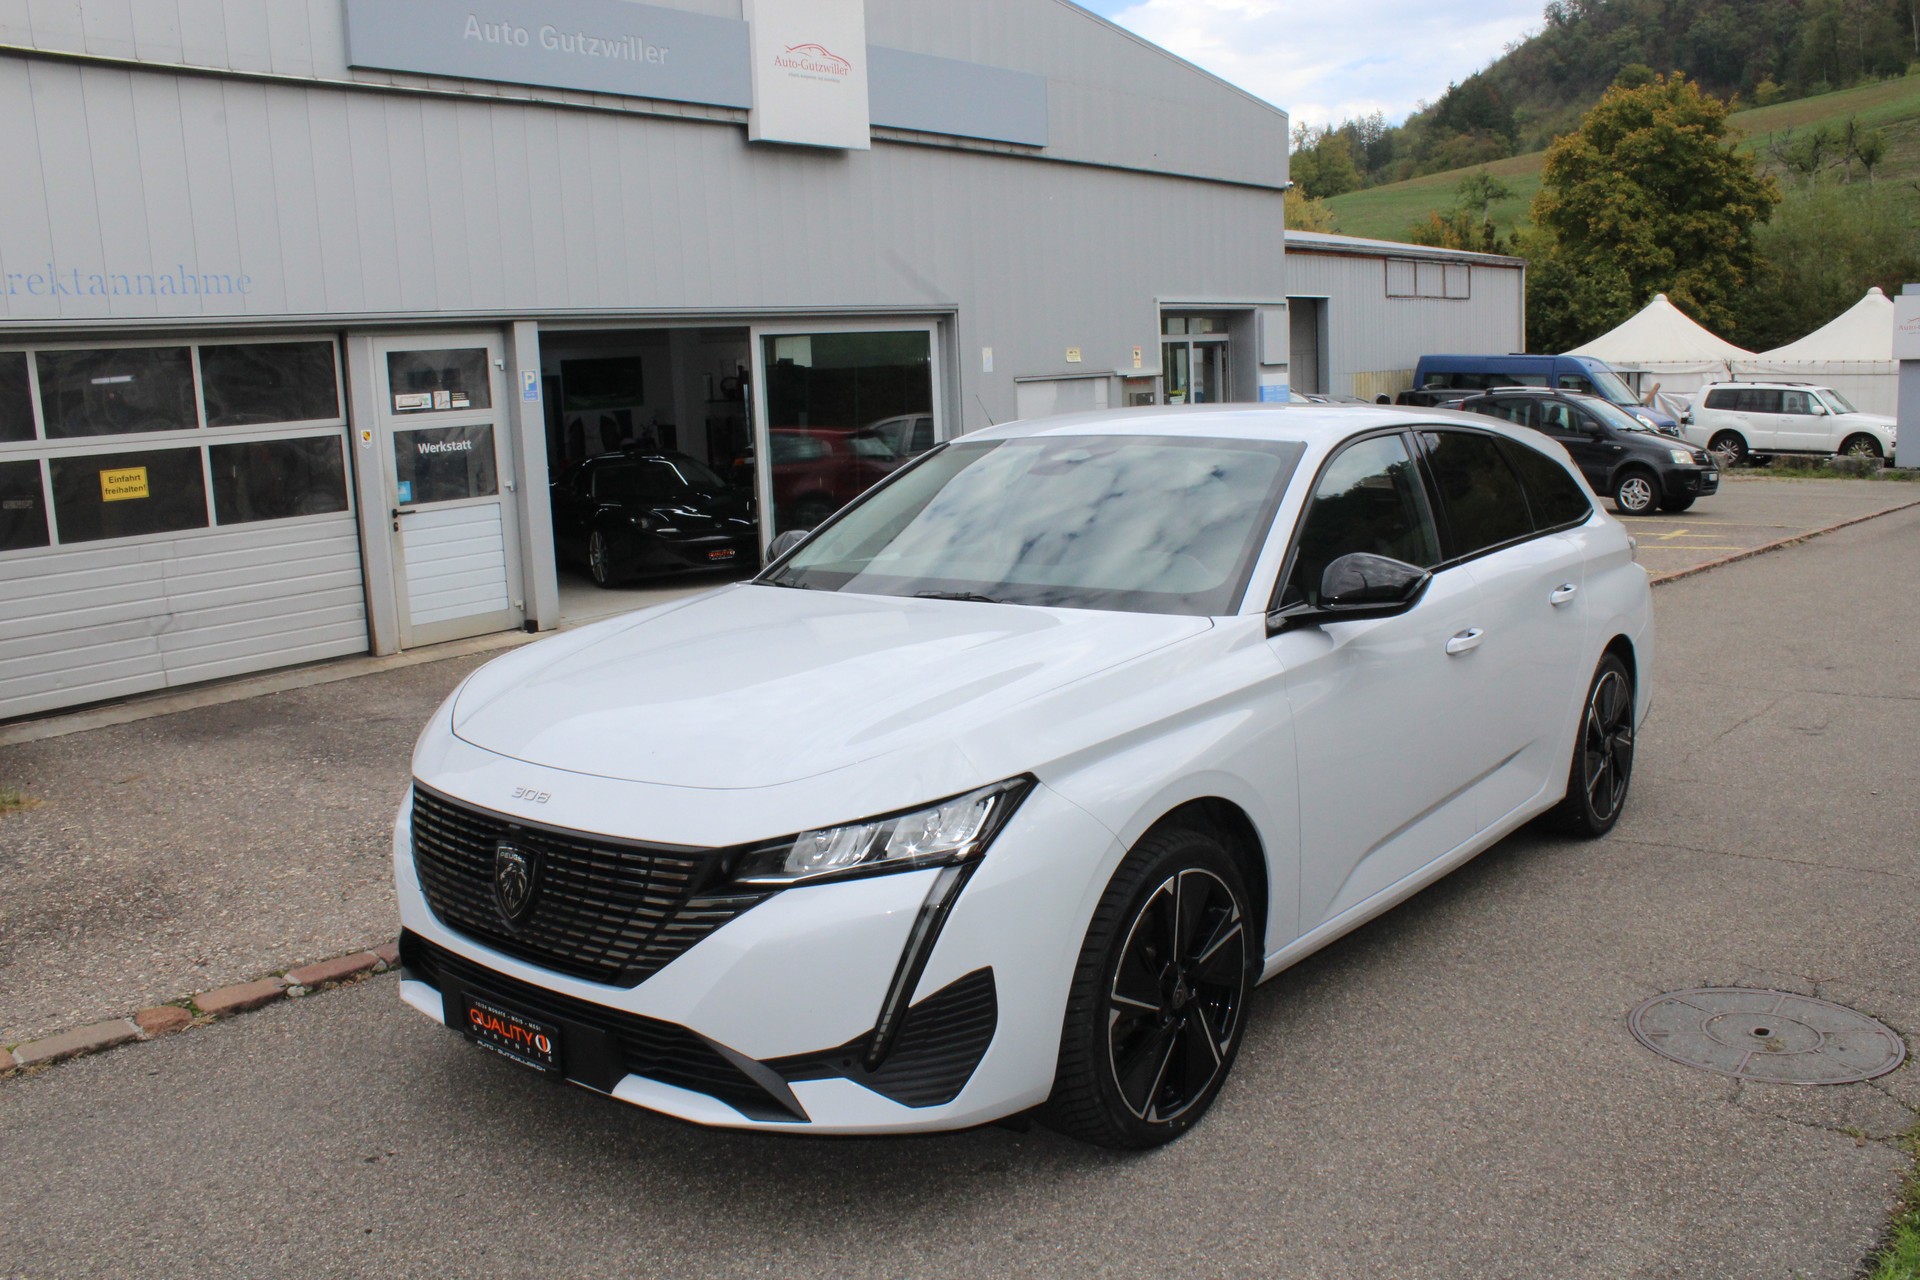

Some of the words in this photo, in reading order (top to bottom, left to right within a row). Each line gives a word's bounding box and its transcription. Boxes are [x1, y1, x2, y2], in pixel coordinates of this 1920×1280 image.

[463, 13, 529, 48] Auto
[539, 24, 669, 65] Gutzwiller
[774, 55, 849, 76] Auto-Gutzwiller
[0, 262, 253, 297] rektannahme
[525, 371, 536, 391] P
[417, 440, 472, 454] Werkstatt
[108, 474, 142, 484] Einfahrt
[105, 484, 146, 495] freihalten!
[511, 787, 552, 804] 308
[470, 1008, 534, 1046] QUALITY
[473, 1024, 552, 1063] GARANTIE
